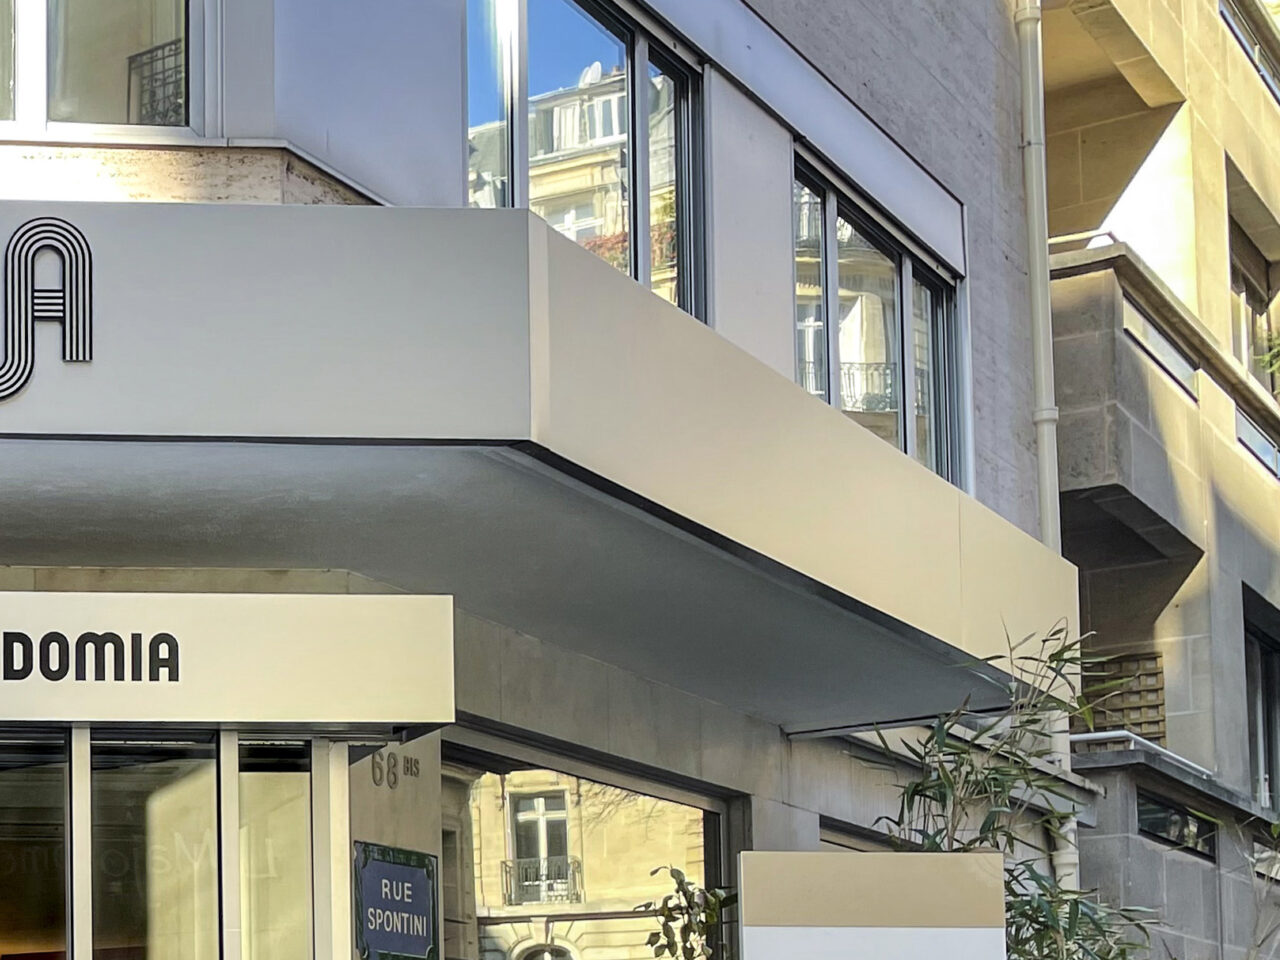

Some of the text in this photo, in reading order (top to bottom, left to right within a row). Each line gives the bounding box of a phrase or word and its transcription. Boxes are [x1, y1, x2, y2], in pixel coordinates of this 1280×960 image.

[371, 750, 399, 790] 68
[381, 878, 412, 903] RUE
[367, 907, 427, 938] SPONTINI
